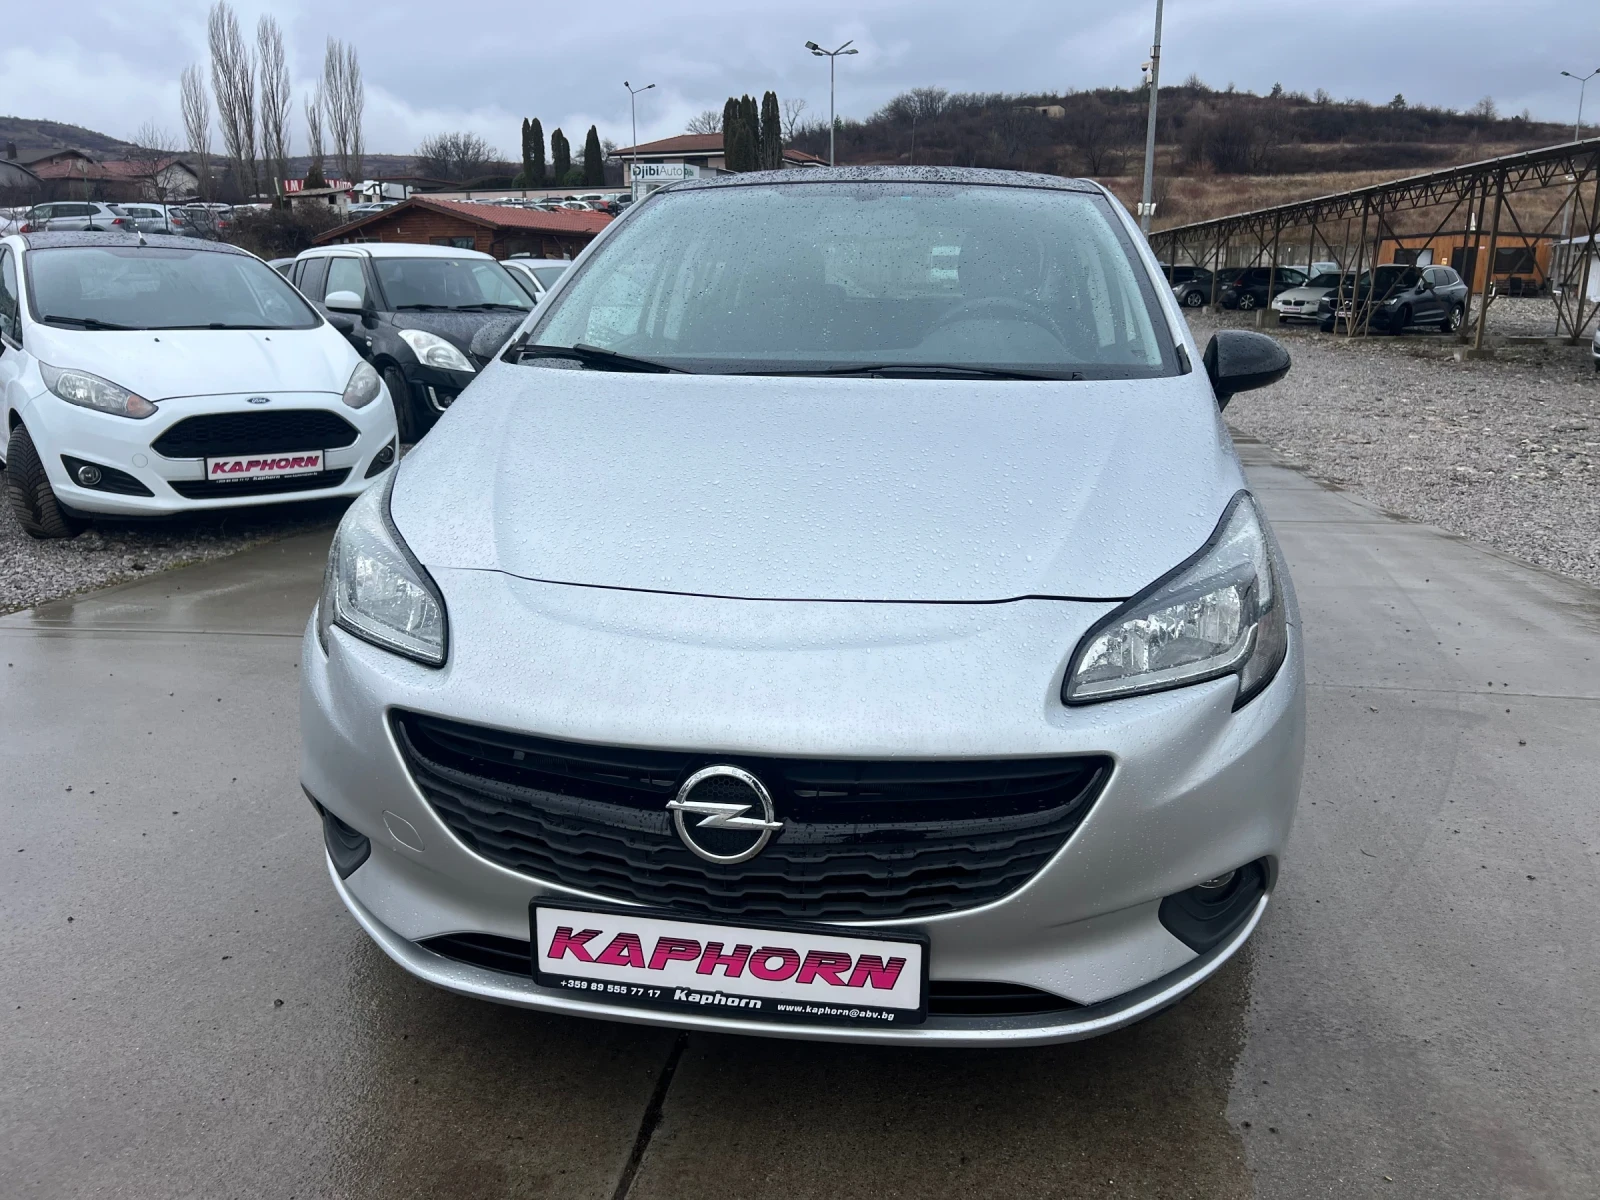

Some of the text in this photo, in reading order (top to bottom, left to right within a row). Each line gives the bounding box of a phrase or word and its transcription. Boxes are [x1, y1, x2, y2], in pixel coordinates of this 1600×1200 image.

[211, 456, 320, 474] KAPHORN
[547, 925, 907, 991] KAPHORN
[560, 979, 661, 998] +359 89 555 77 17
[673, 989, 762, 1009] Kaphorn
[777, 1003, 895, 1021] www.kaphorn@abv.bg
